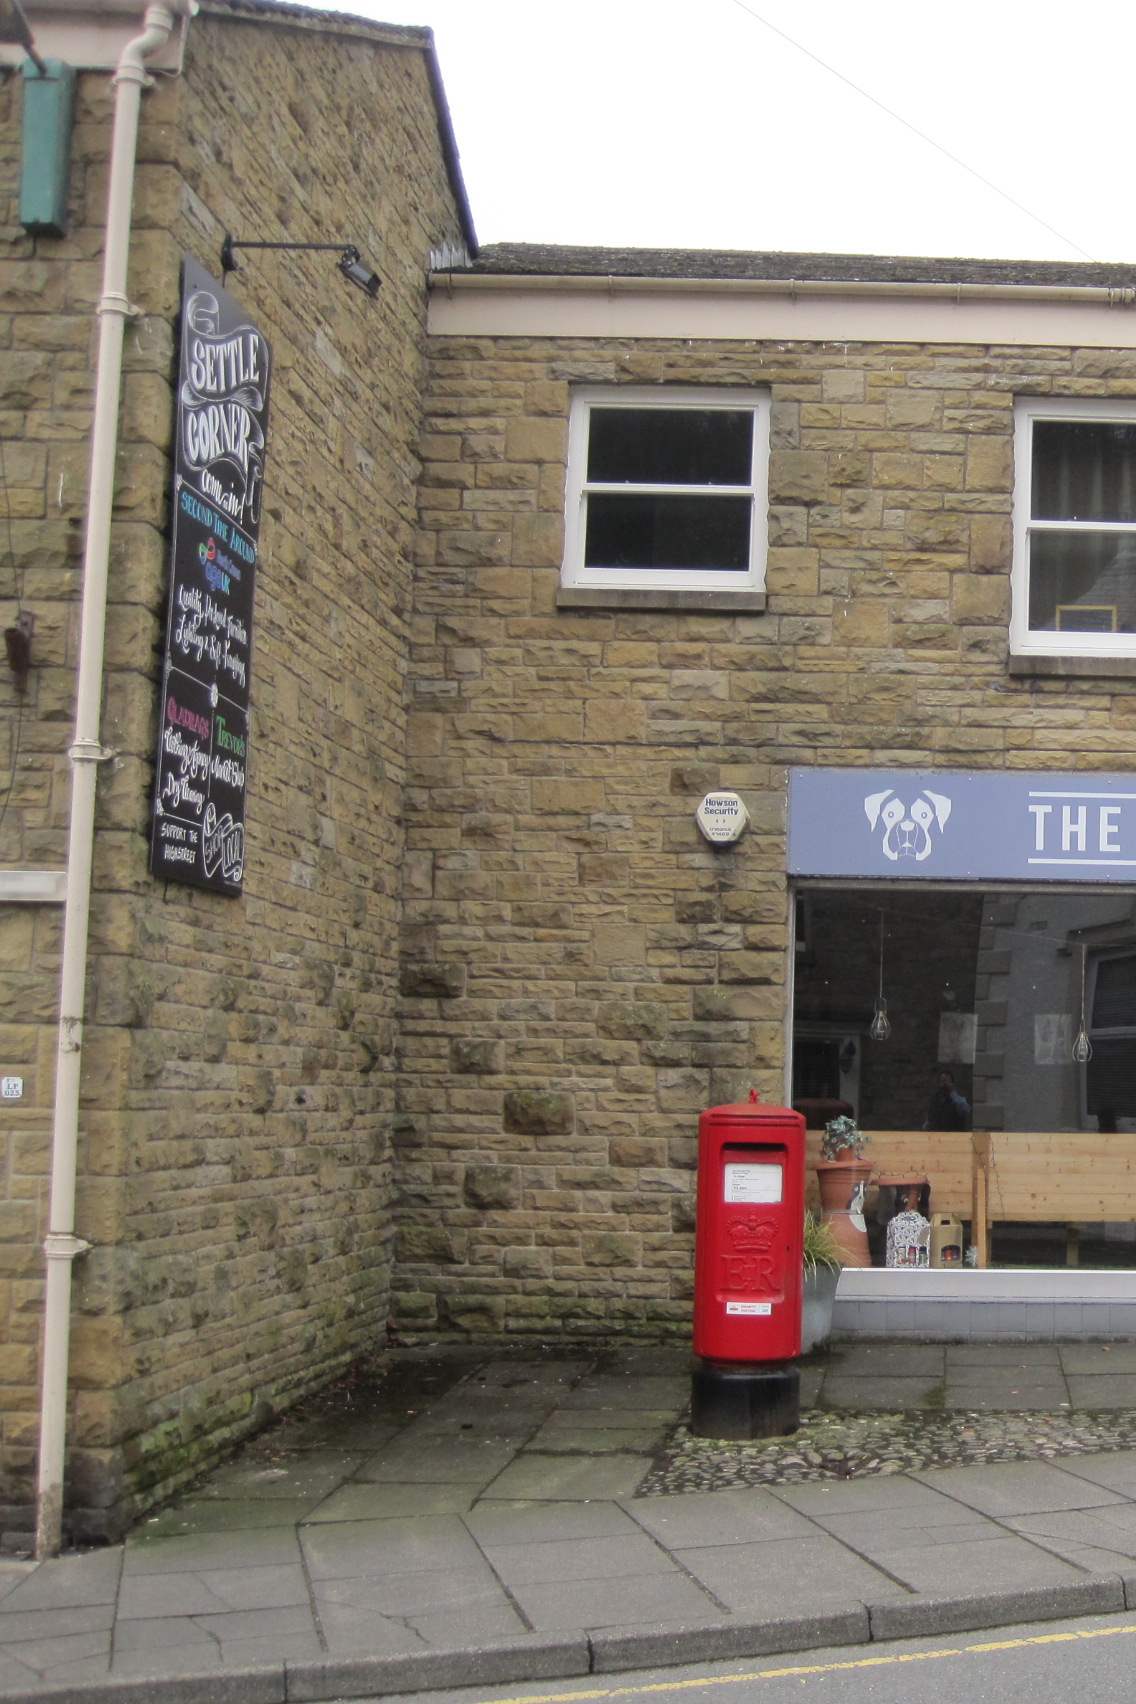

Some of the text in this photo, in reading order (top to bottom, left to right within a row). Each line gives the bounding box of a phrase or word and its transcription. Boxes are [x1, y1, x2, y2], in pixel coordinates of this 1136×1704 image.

[191, 333, 260, 393] SETTLE
[187, 403, 249, 473] CORNER
[181, 491, 213, 528] SECOND
[229, 527, 255, 564] AROUND
[704, 806, 739, 816] Security
[705, 798, 738, 807] Howson
[161, 822, 187, 841] SUPPORT
[204, 824, 224, 864] SHOP
[1028, 804, 1121, 852] THE
[222, 829, 242, 870] LOCAL
